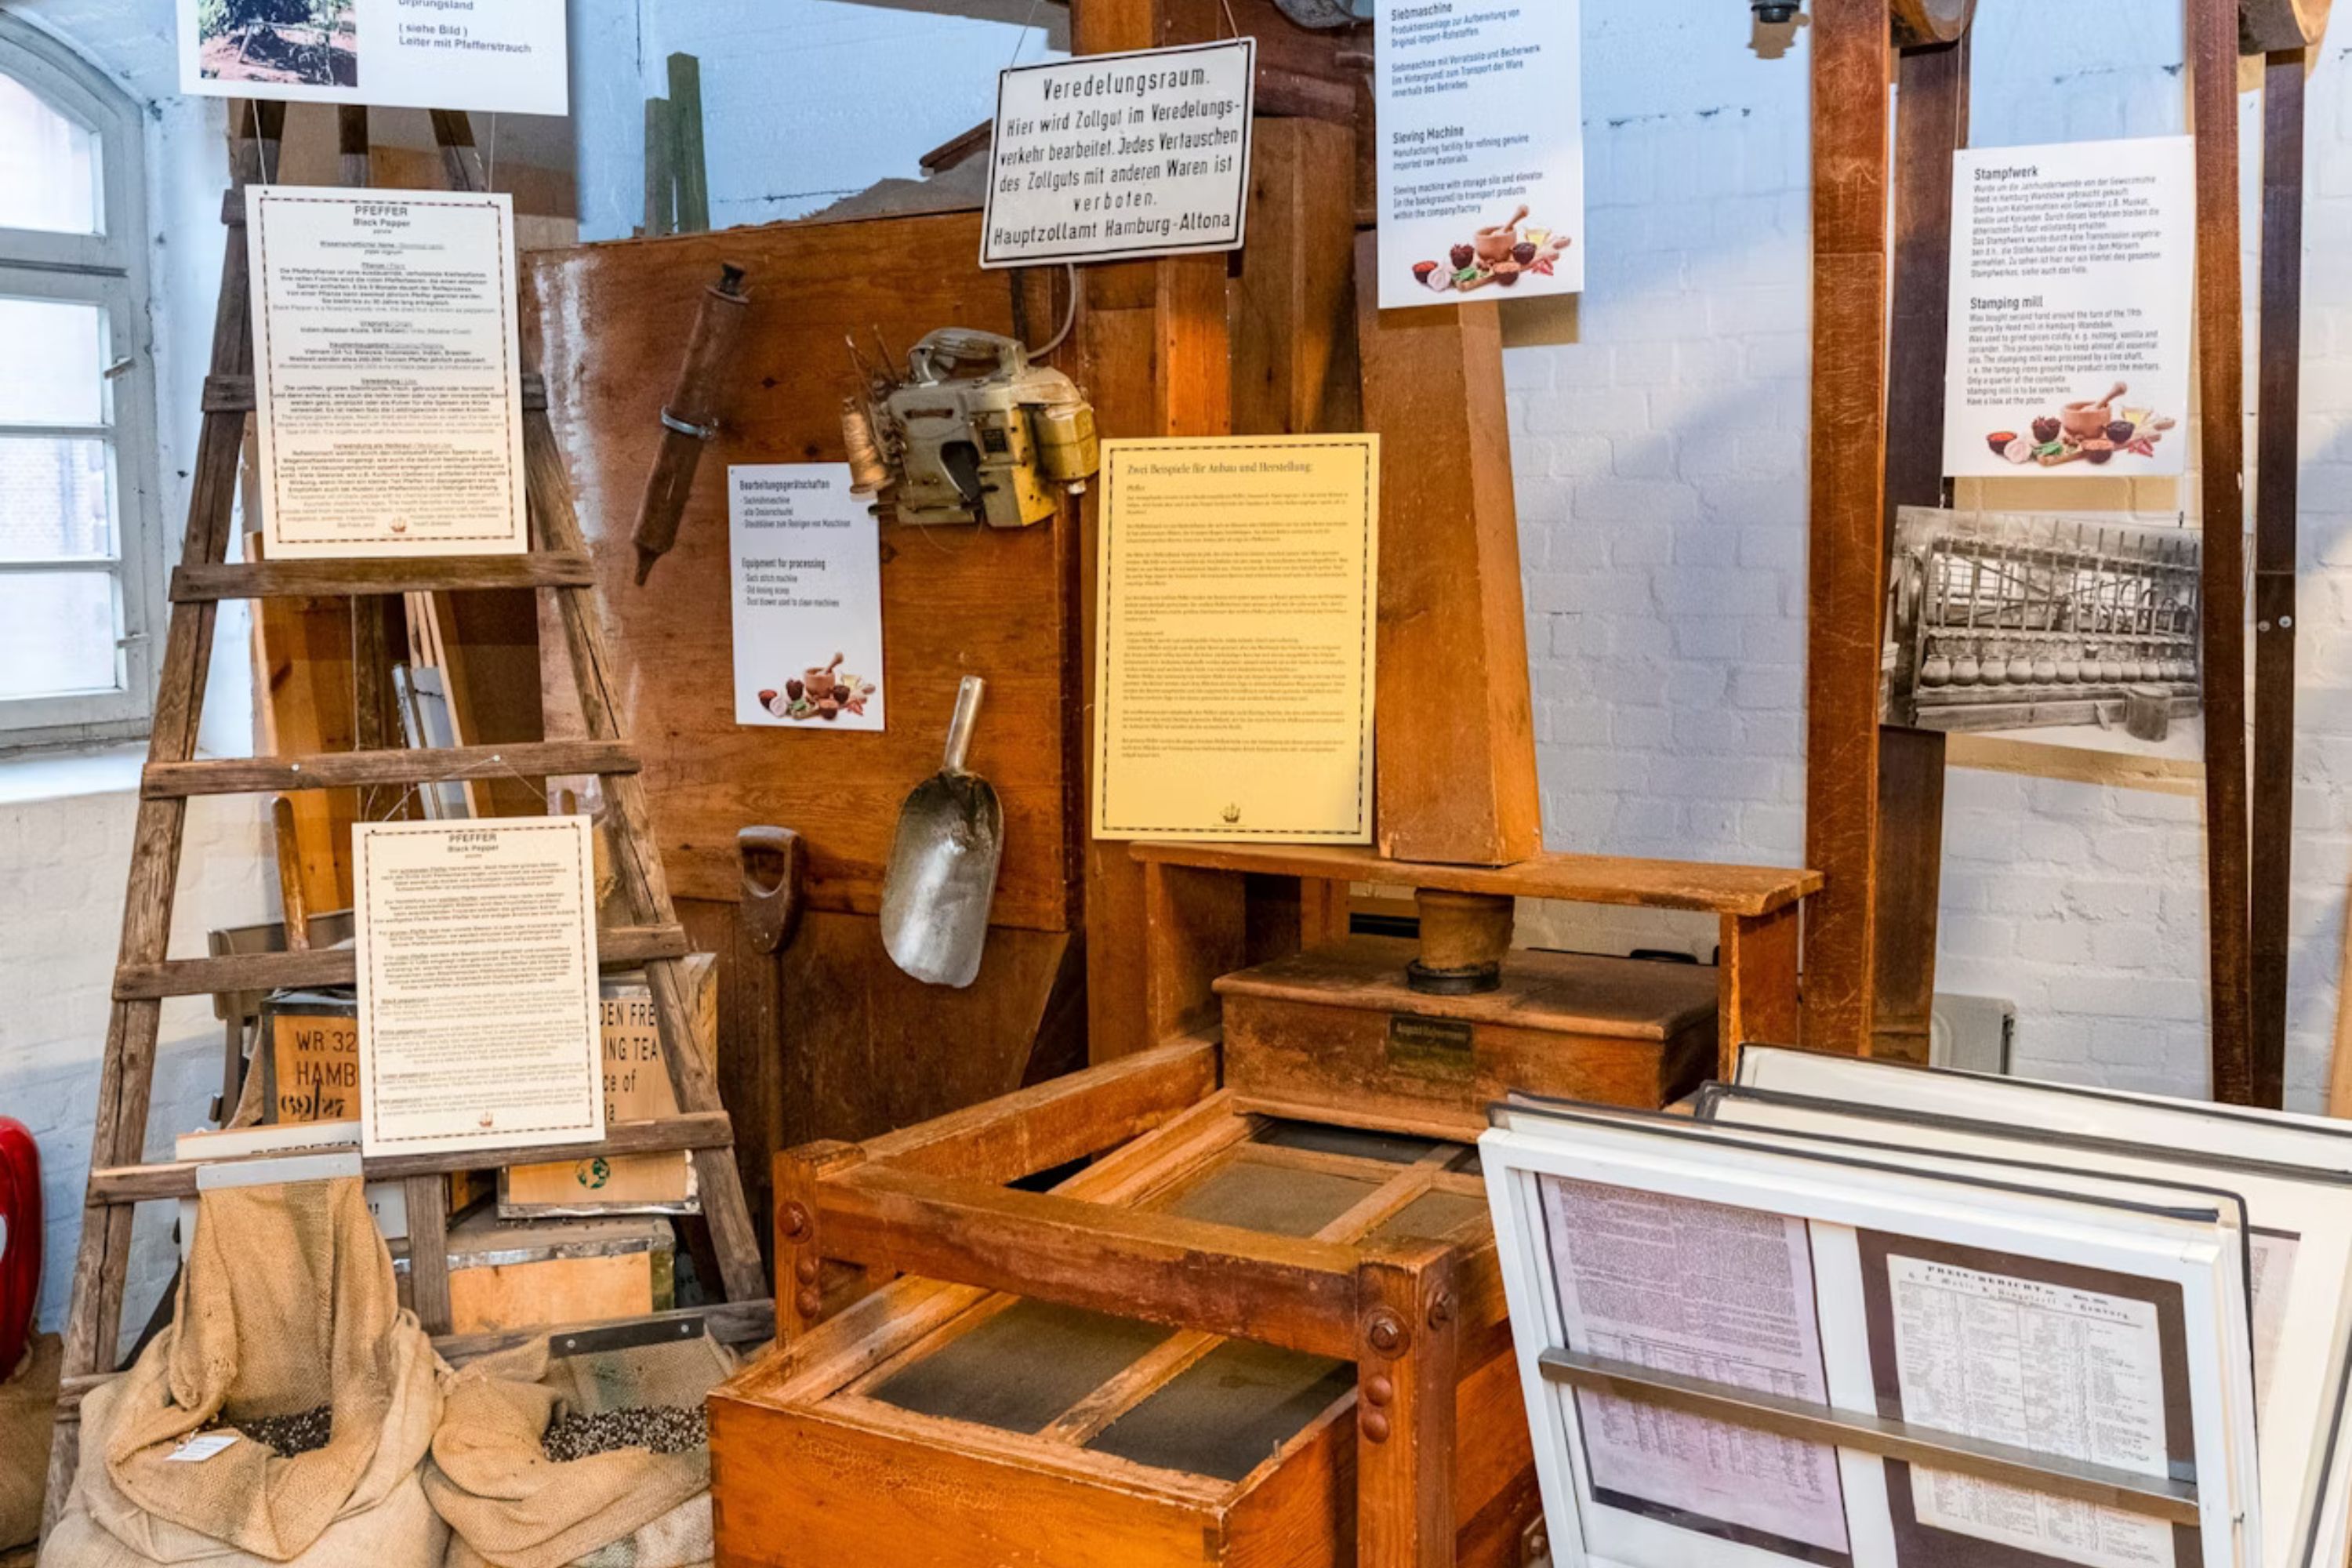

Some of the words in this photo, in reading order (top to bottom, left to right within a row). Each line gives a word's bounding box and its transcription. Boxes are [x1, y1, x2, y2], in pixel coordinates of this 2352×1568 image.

[1392, 4, 1452, 21] Siebmaschine
[406, 24, 436, 34] siehe
[439, 25, 460, 35] Bild
[399, 36, 430, 46] Leiter
[434, 39, 452, 48] mit
[455, 40, 532, 53] Pfefferstrauch
[1044, 68, 1210, 100] Veredelungsraum.
[1007, 119, 1034, 136] Hier
[1040, 113, 1069, 132] wird
[1075, 108, 1122, 130] Zollgut
[1128, 107, 1144, 123] im
[1152, 99, 1241, 122] Veredelungs-
[1392, 130, 1425, 144] Sieving
[1427, 126, 1464, 140] Machine
[1000, 147, 1045, 166] verkehr
[1049, 140, 1115, 162] bearbeitet.
[1119, 136, 1155, 154] Jedes
[1159, 129, 1238, 151] Vertauschen
[1000, 176, 1019, 192] des
[1027, 171, 1079, 192] Zollguts
[1084, 168, 1103, 185] mit
[1111, 163, 1160, 183] anderen
[1167, 158, 1207, 177] Waren
[1214, 155, 1232, 173] ist
[1974, 165, 2038, 181] Stampfwerk
[354, 205, 408, 216] PFEFFER
[1073, 191, 1157, 212] verboten.
[380, 219, 410, 229] Pepper
[993, 222, 1096, 248] Hauptzollamt
[1105, 212, 1230, 238] Hamburg-Altona
[1970, 296, 2020, 310] Stamping
[2022, 296, 2043, 308] mill
[449, 833, 496, 843] PFEFFER
[296, 1030, 325, 1051] WR
[332, 1031, 357, 1052] 32
[633, 1037, 658, 1060] TEA
[622, 1069, 636, 1092] of
